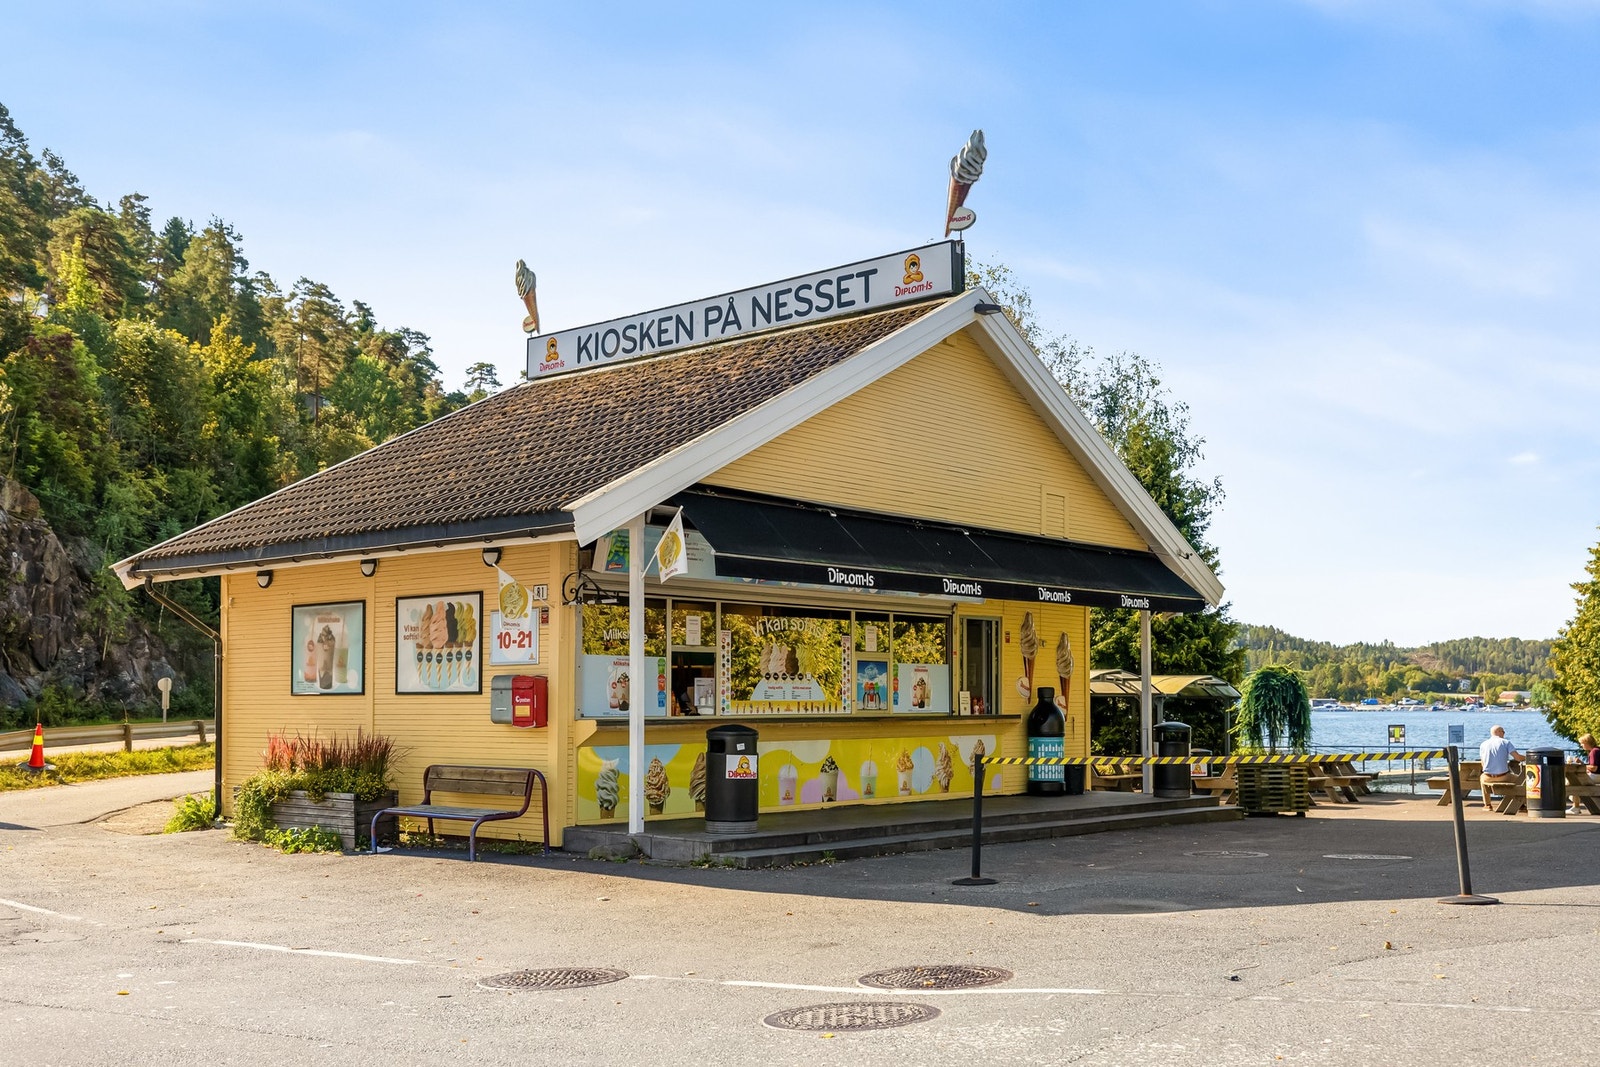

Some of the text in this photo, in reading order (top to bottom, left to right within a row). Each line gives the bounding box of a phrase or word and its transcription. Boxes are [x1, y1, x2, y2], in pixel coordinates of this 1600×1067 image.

[577, 268, 878, 364] KIOSKEN PÅ NESSET
[536, 586, 545, 598] 81
[765, 617, 789, 632] kan
[497, 630, 533, 649] 10-21
[603, 628, 648, 643] Milkse
